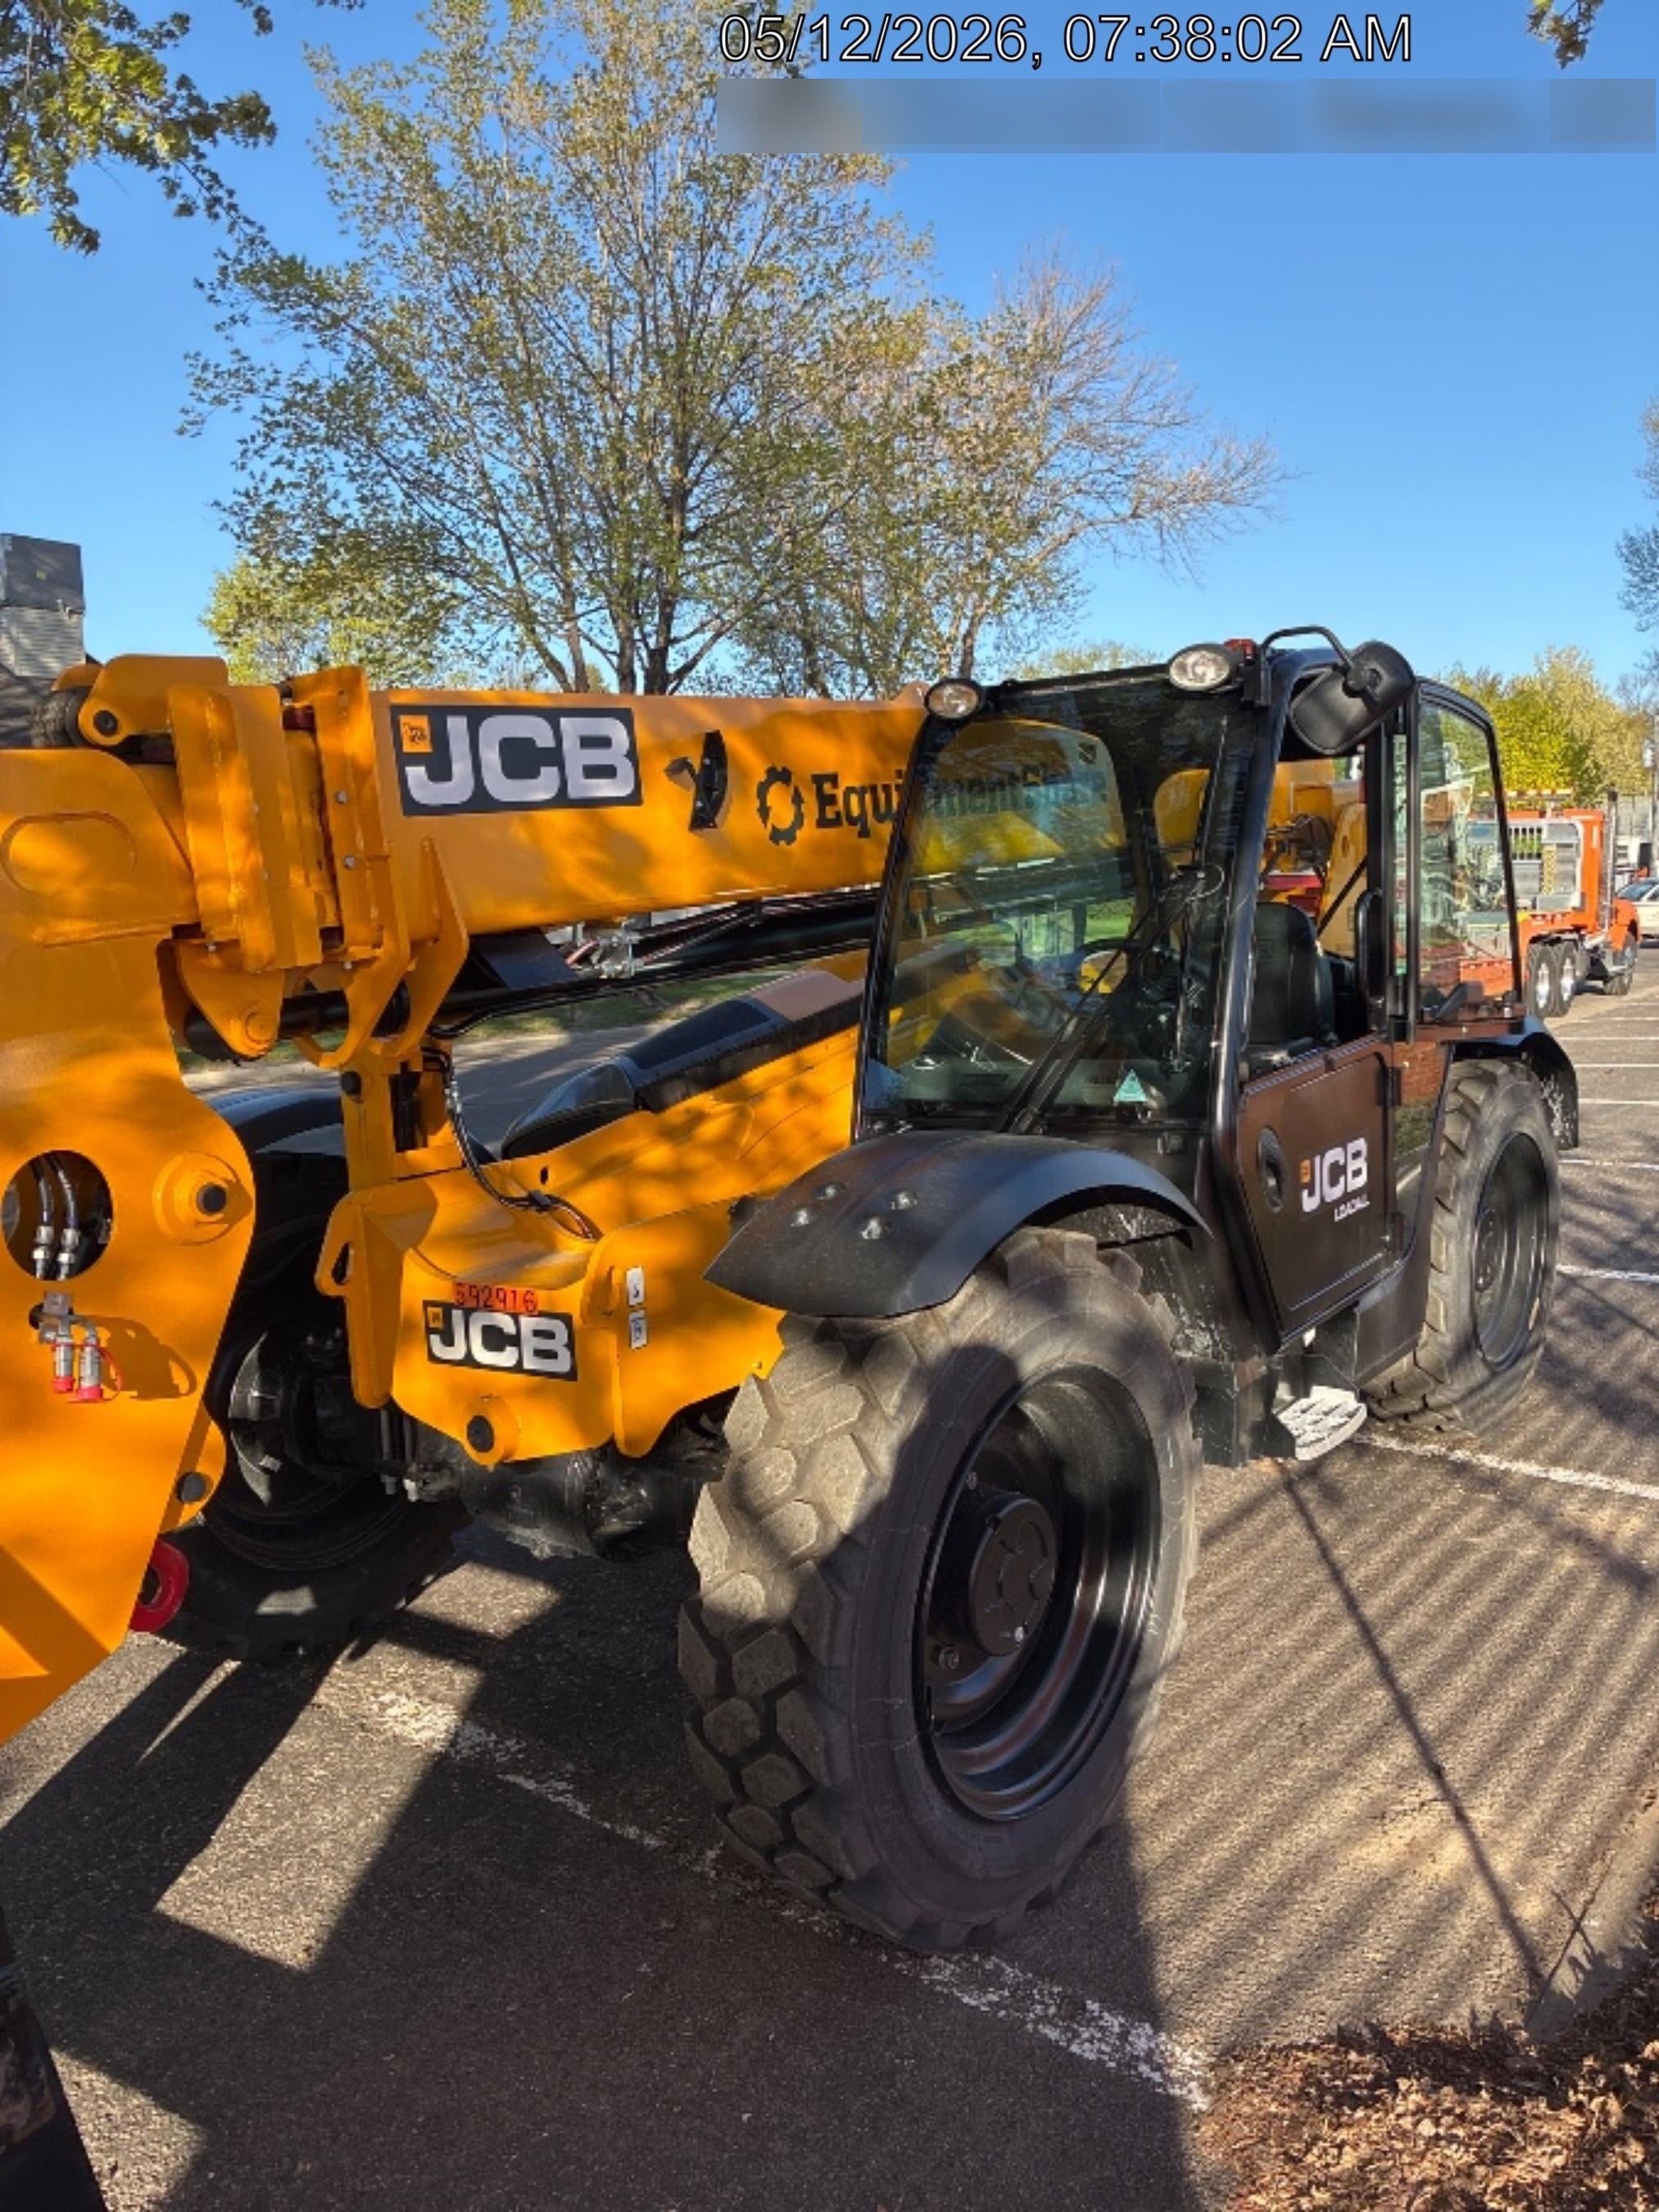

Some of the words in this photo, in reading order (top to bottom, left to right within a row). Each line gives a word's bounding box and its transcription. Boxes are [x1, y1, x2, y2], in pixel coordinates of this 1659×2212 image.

[405, 714, 636, 806] JCB
[1302, 1137, 1368, 1213] JCB
[429, 1309, 572, 1373] JCB
